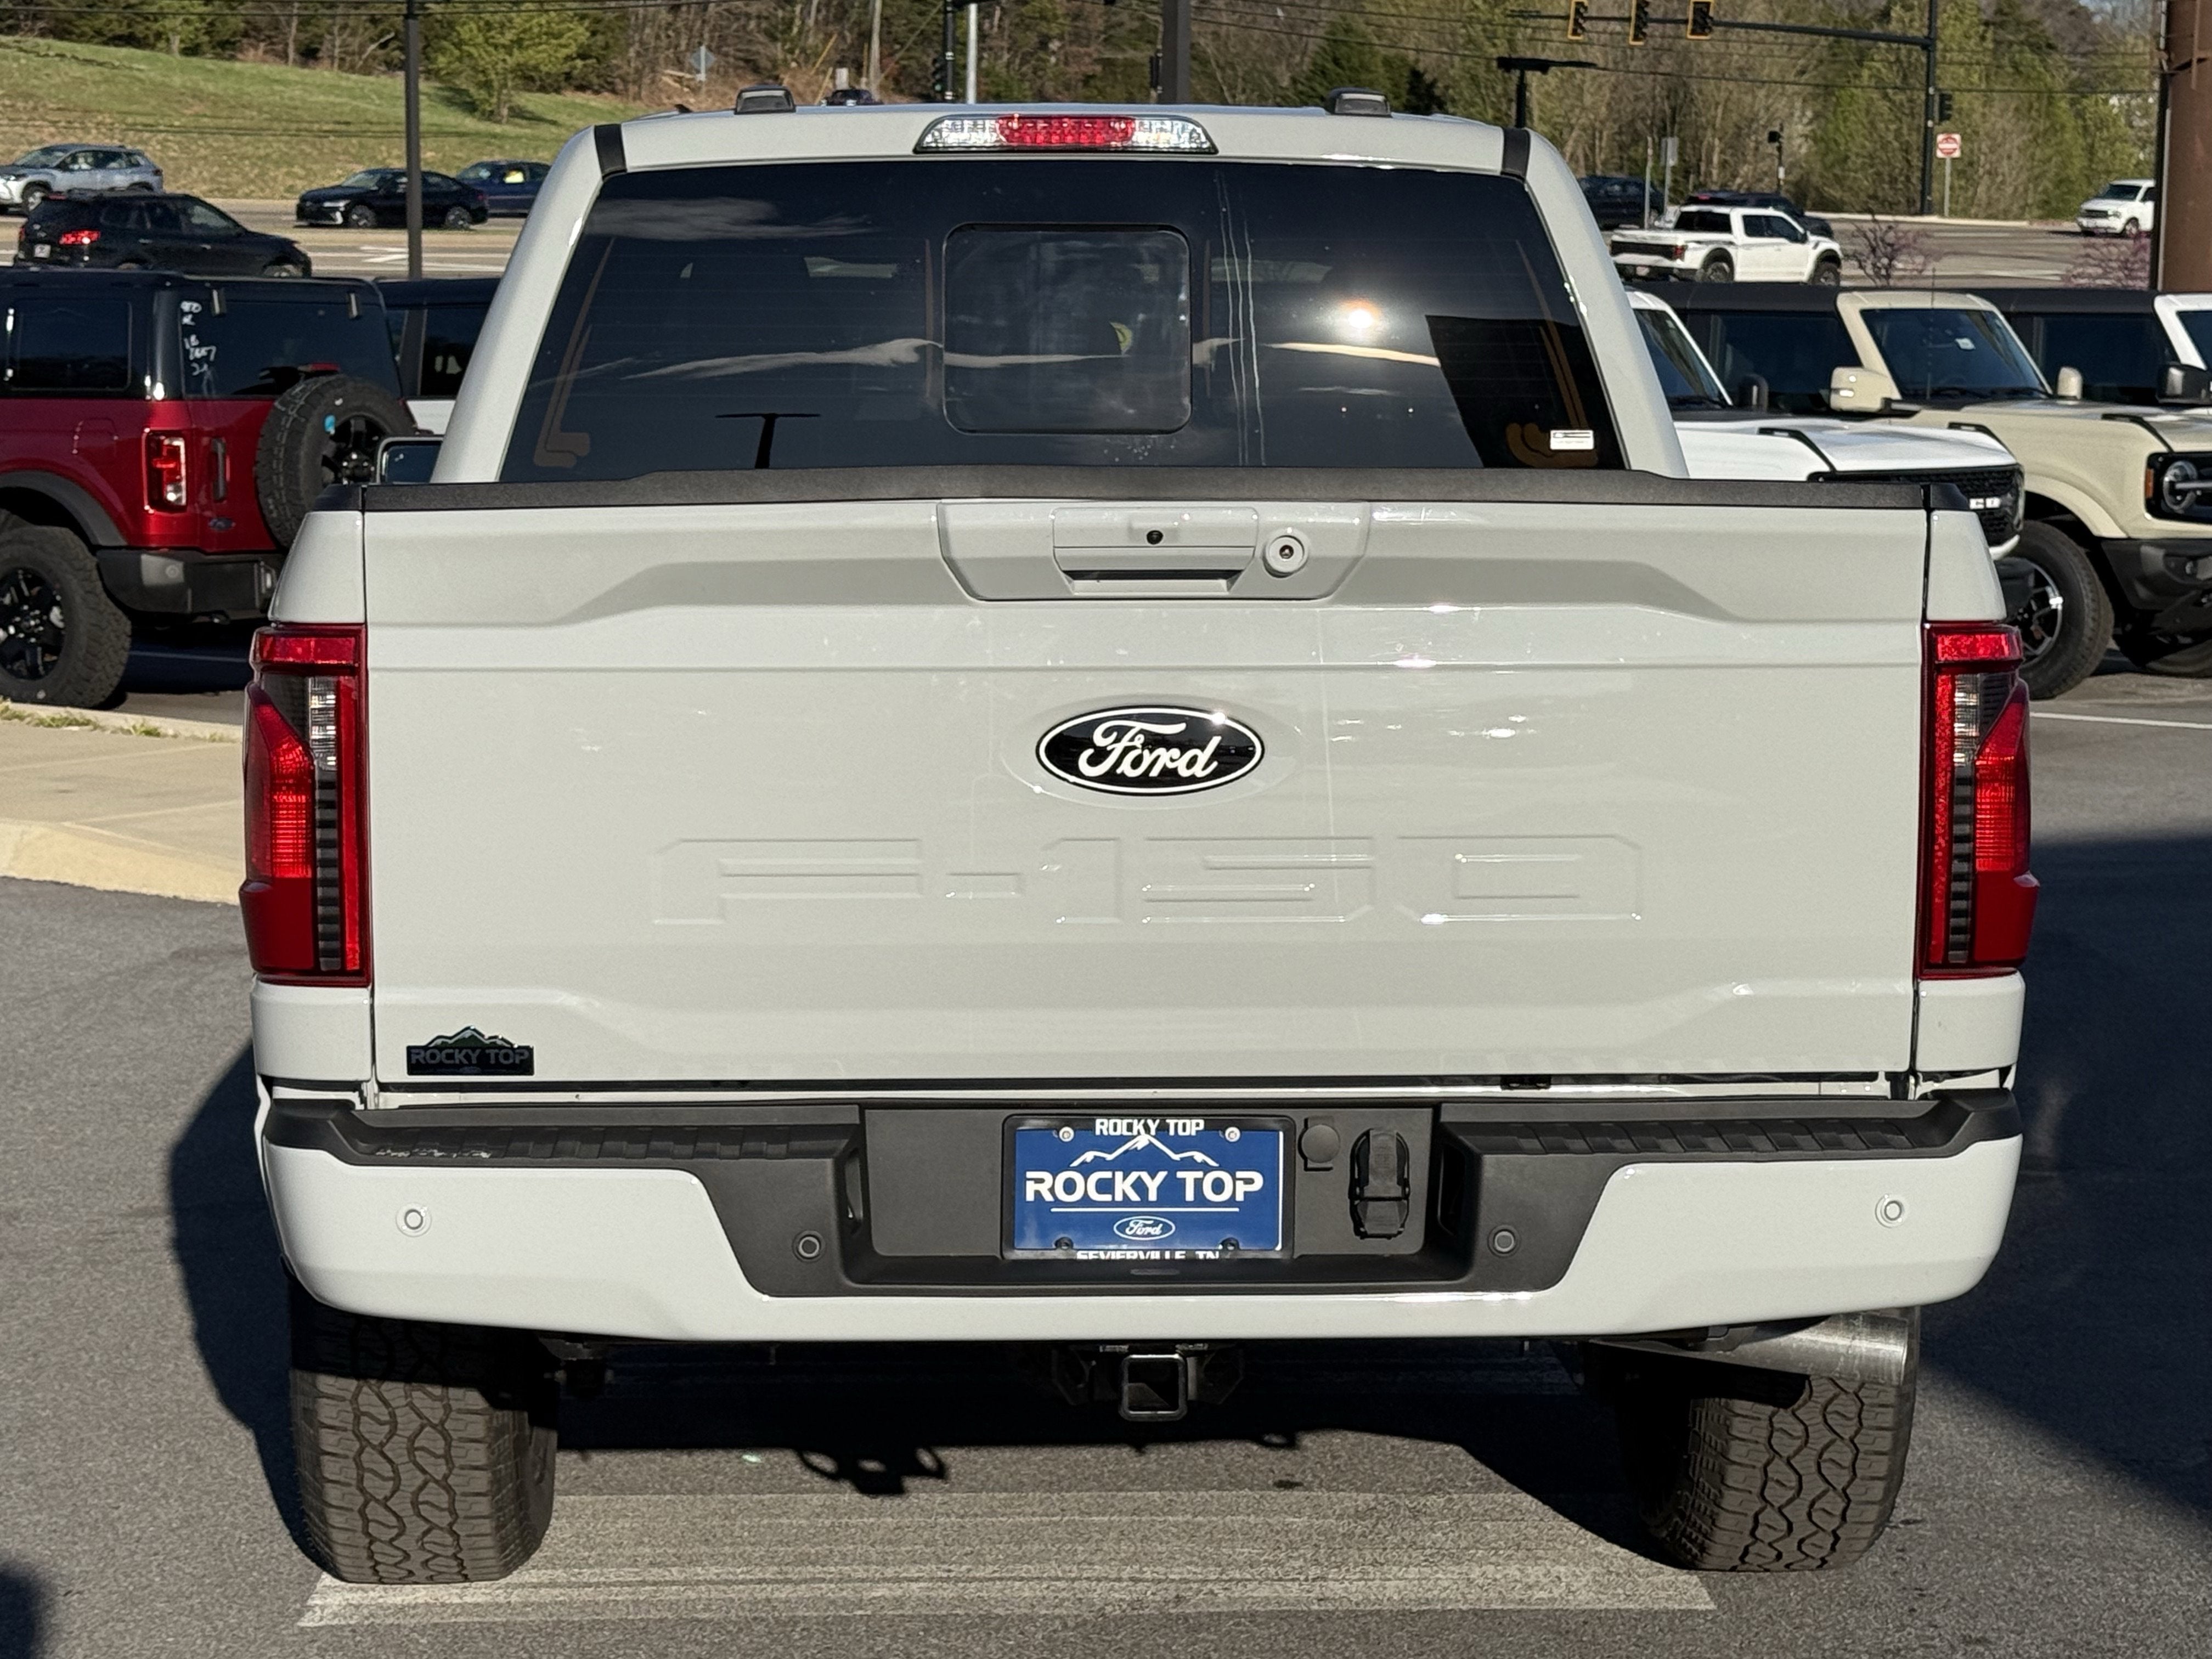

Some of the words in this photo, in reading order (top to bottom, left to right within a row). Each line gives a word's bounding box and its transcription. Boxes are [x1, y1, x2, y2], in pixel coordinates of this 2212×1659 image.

[1078, 720, 1222, 777] Ford
[652, 835, 1641, 925] F-150
[411, 1048, 481, 1064] ROCKY
[486, 1048, 530, 1064] TOP
[1095, 1119, 1160, 1136] ROCKY
[1165, 1119, 1205, 1136] TOP
[1025, 1170, 1168, 1202] ROCKY
[1176, 1170, 1264, 1202] TOP
[1125, 1219, 1163, 1235] Ford
